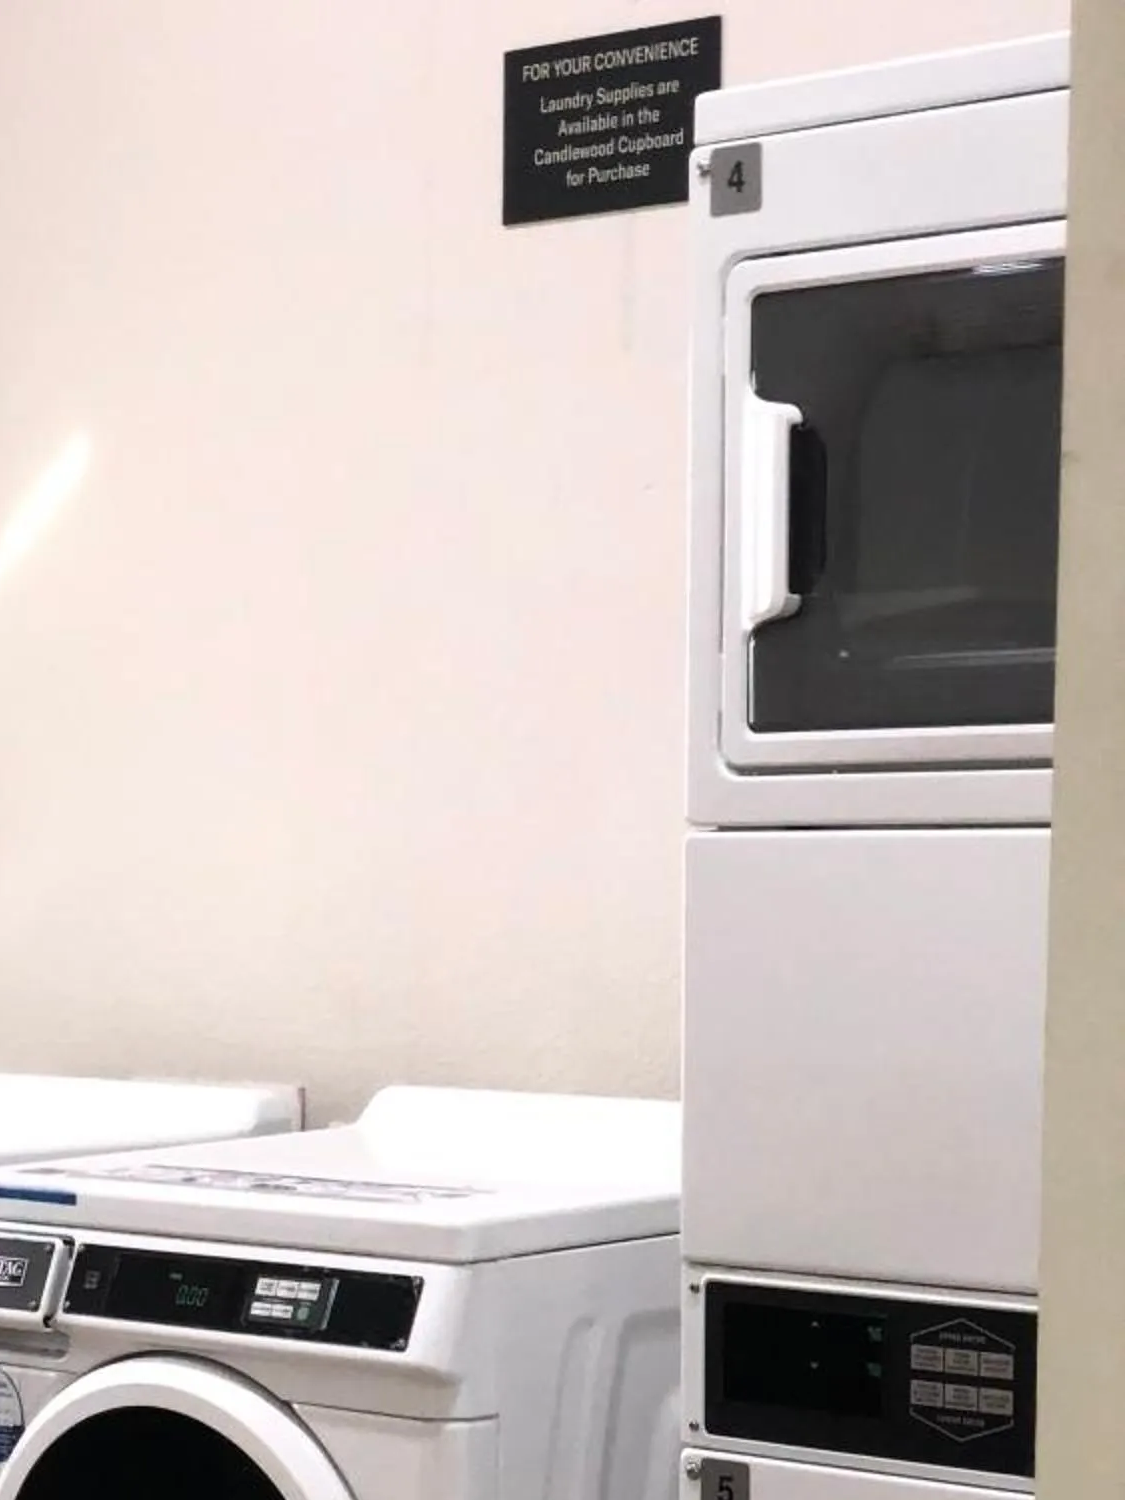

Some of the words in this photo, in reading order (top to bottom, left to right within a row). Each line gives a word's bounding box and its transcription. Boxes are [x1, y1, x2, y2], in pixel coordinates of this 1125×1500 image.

[522, 63, 550, 82] FOR
[555, 55, 592, 77] YOUR
[594, 37, 700, 71] CONVENIENCE
[540, 91, 594, 113] Laundry
[596, 80, 654, 106] Supplies
[657, 79, 680, 95] are
[557, 113, 618, 136] Available
[622, 110, 635, 127] in
[638, 106, 660, 125] the
[534, 137, 615, 166] Candlewood
[618, 127, 685, 156] Cupboard
[566, 169, 585, 187] for
[588, 162, 651, 184] Purchase
[727, 160, 745, 193] 4
